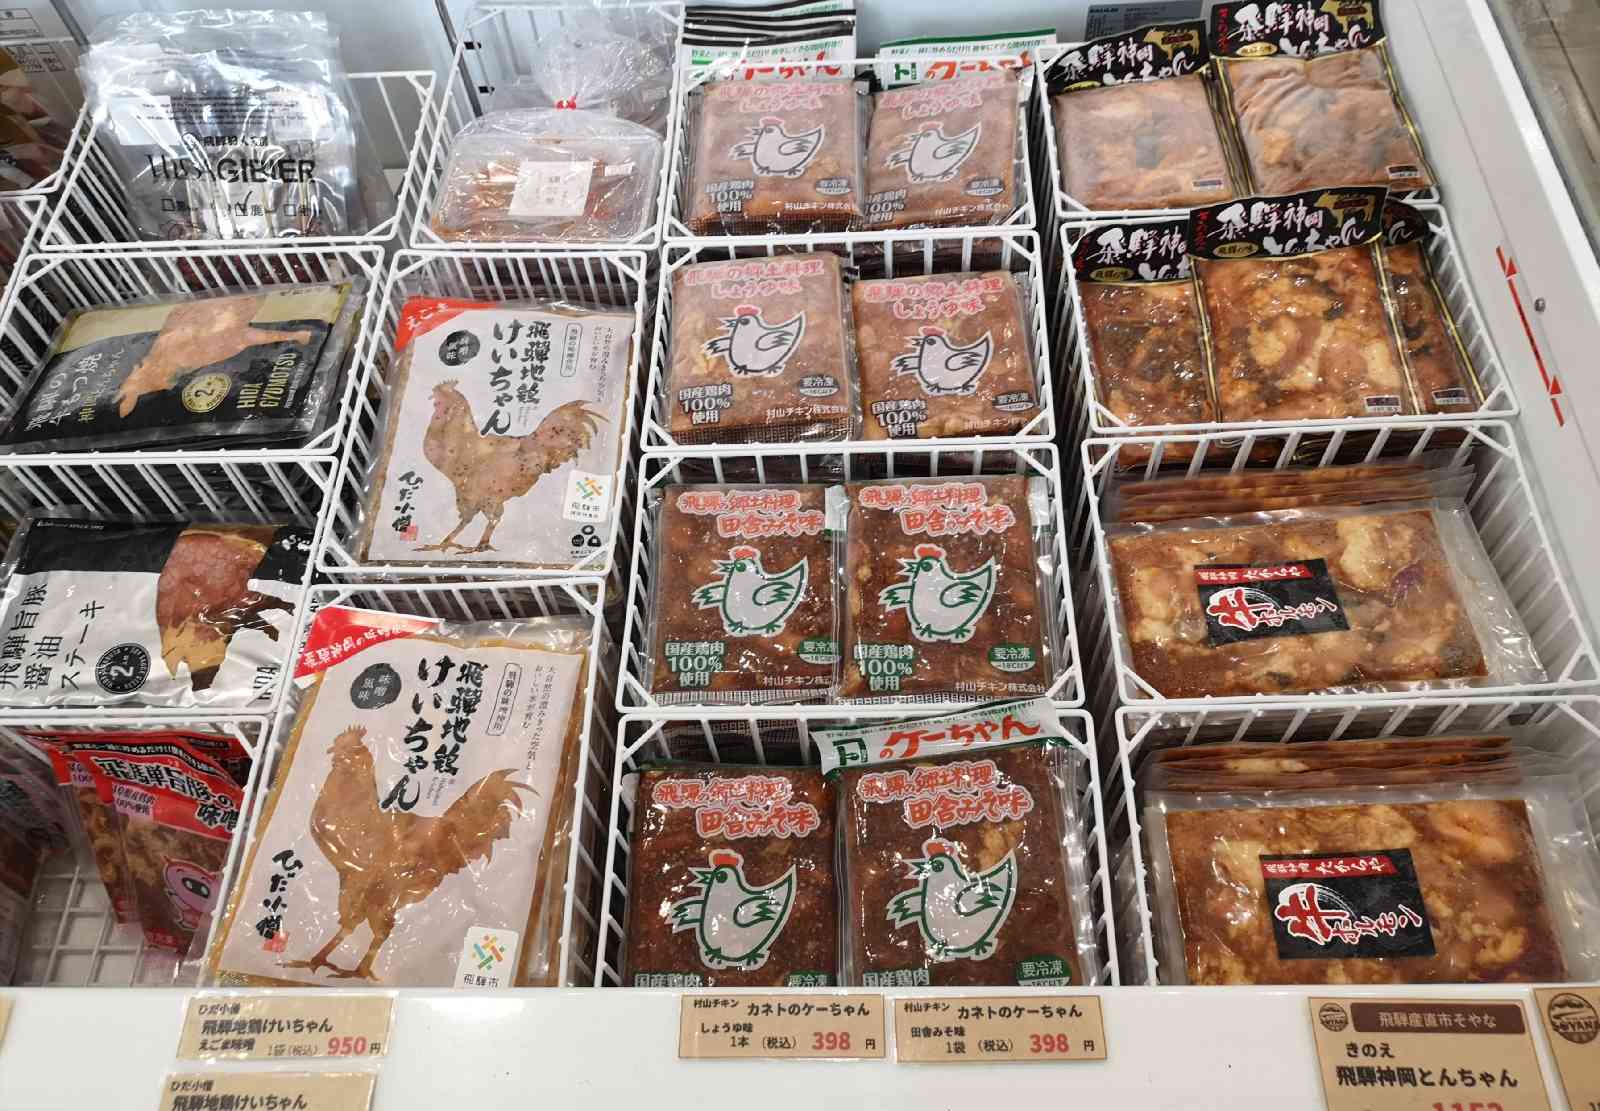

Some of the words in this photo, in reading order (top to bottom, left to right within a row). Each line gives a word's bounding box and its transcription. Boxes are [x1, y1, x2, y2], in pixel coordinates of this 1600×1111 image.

[682, 398, 731, 413] 100%
[692, 411, 720, 424] 使用
[876, 411, 929, 427] 100%
[60, 599, 105, 691] ステーキ
[664, 641, 725, 657] 国産鶏肉
[853, 644, 914, 660] 国産鶏肉
[993, 647, 1030, 661] 要冷凍
[668, 655, 723, 673] 100%
[857, 659, 913, 677] 100%
[679, 673, 710, 688] 使用
[868, 675, 901, 692] 使用
[380, 655, 456, 811] けいちゃん
[1020, 961, 1064, 977] 要冷凍
[862, 969, 930, 987] 国産鶏肉
[746, 1002, 871, 1018] カネトのケーちゃん
[957, 1003, 1083, 1020] カネトのケーちゃん
[700, 1022, 754, 1034] しょうゆ味
[327, 1036, 368, 1057] 950
[369, 1042, 382, 1056] 円
[729, 1036, 750, 1049] 1本
[811, 1031, 851, 1051] 398
[865, 1038, 877, 1050] 円
[1029, 1033, 1070, 1054] 398
[1083, 1039, 1096, 1052] 円
[1345, 1042, 1395, 1059] きのえ
[1336, 1065, 1519, 1088] 飛騨神岡とんちゃん
